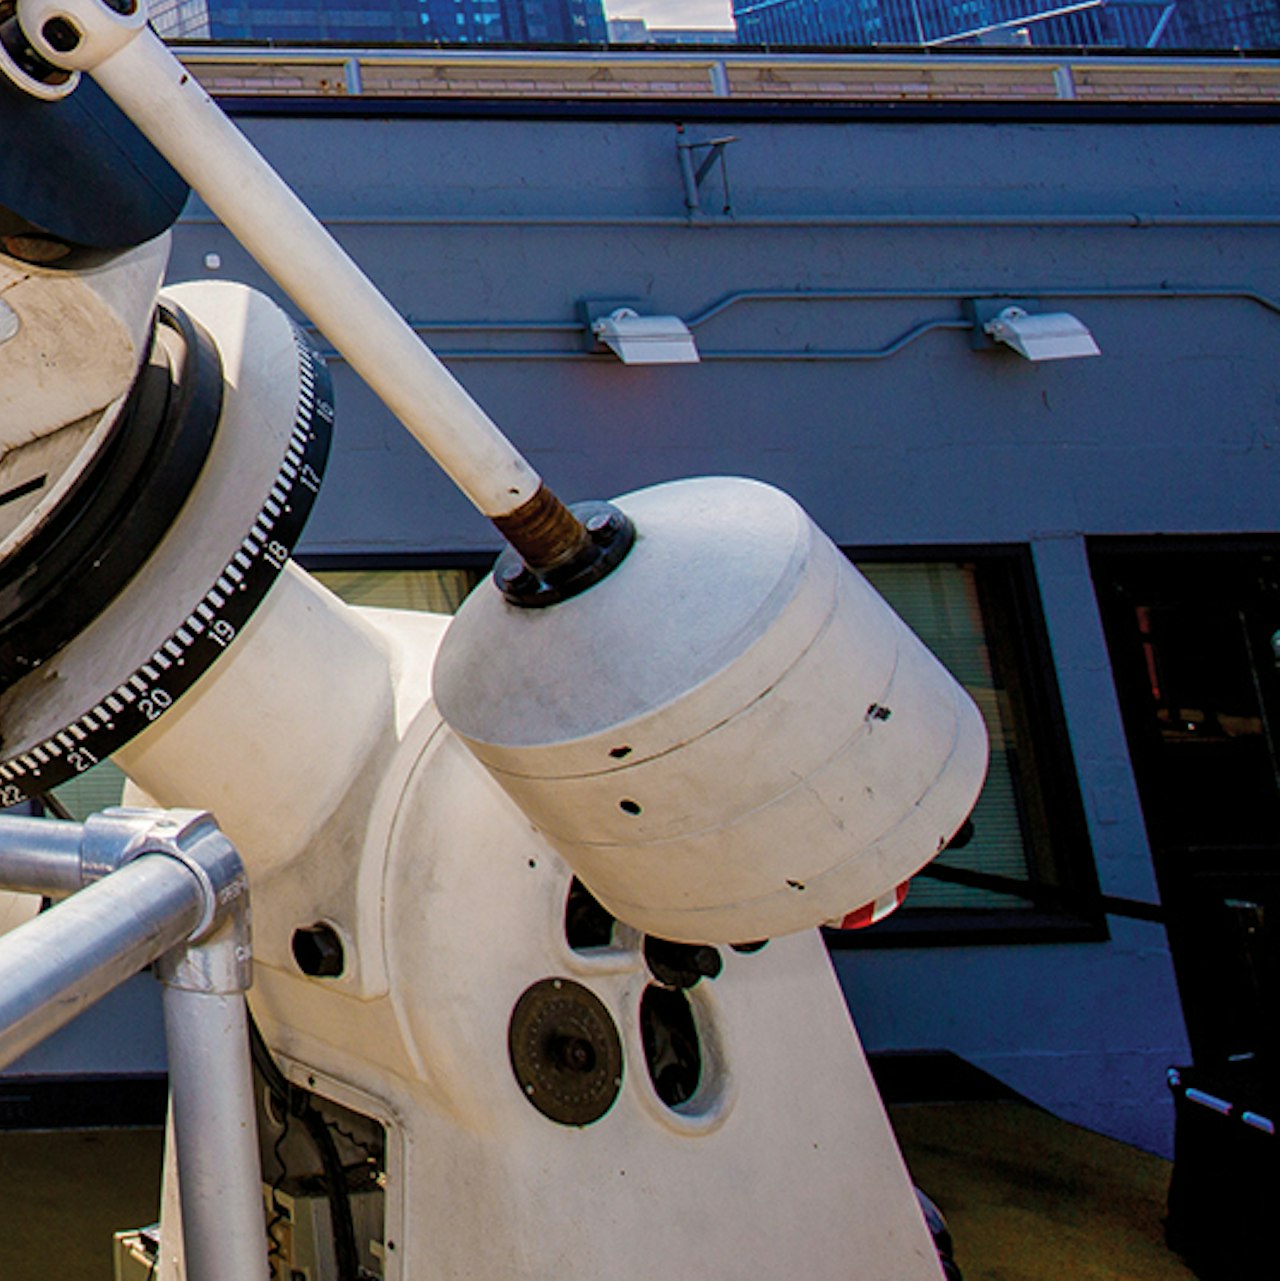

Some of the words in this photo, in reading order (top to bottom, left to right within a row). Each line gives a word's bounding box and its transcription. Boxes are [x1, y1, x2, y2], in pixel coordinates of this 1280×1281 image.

[299, 464, 321, 492] 17
[263, 540, 289, 570] 18
[207, 619, 236, 647] 19
[138, 688, 173, 721] 20
[67, 746, 99, 772] 21
